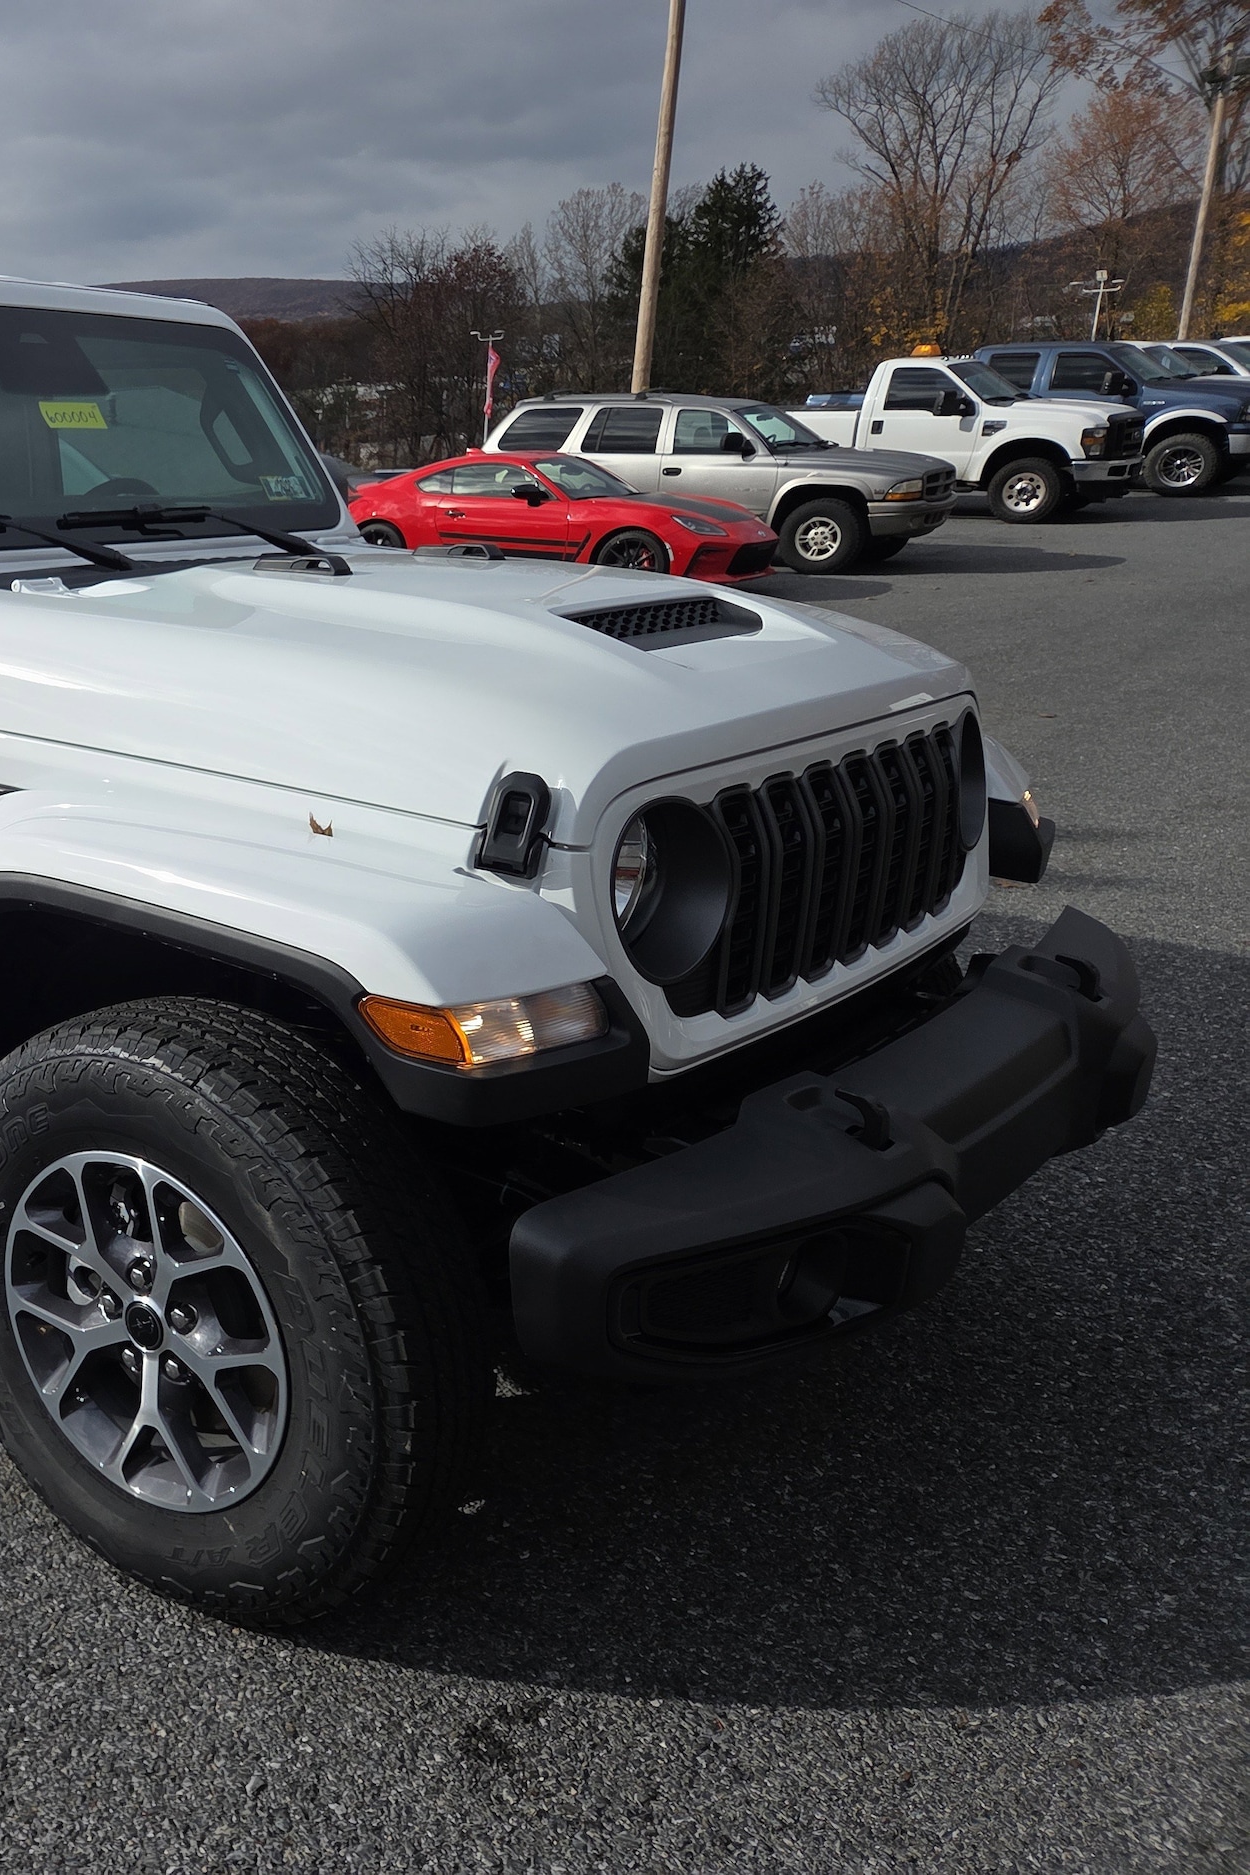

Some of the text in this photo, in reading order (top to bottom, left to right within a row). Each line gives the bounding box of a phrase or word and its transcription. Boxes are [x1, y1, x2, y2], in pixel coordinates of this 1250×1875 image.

[46, 410, 98, 423] 600004
[165, 1270, 332, 1567] DUELER A/T
